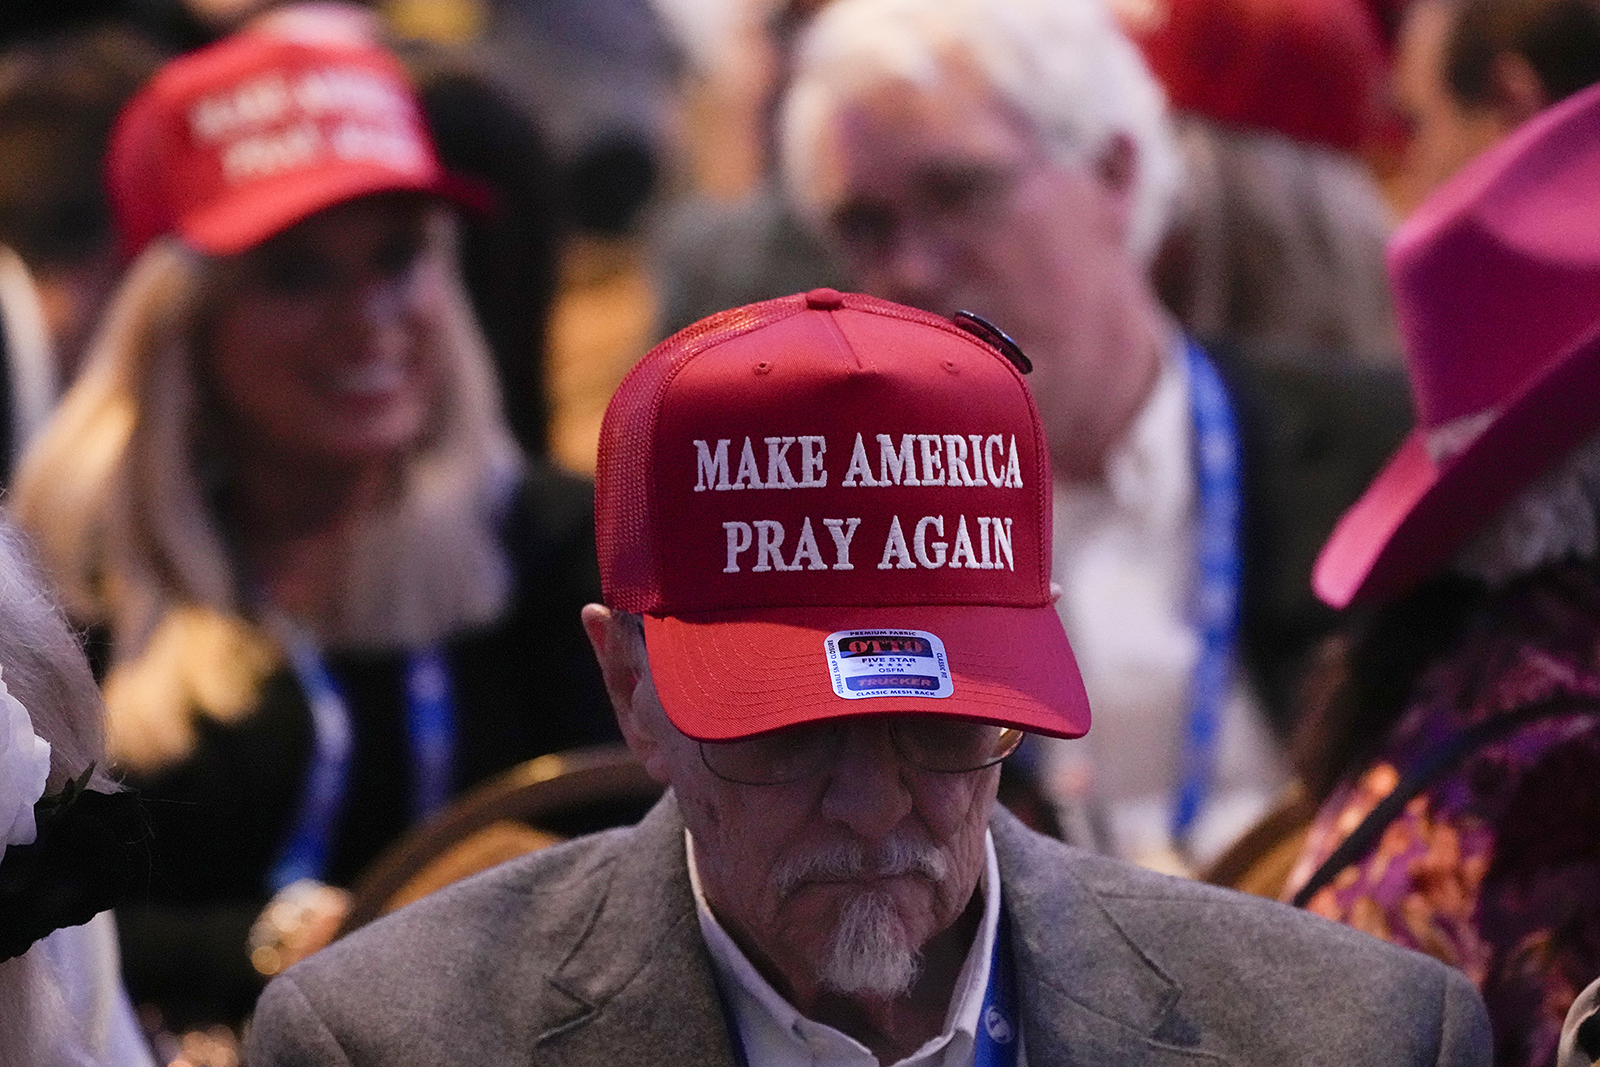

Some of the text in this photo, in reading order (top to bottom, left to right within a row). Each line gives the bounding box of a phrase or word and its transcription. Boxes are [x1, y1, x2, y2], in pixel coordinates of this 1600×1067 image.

[693, 432, 1023, 492] MAKE AMERICA
[722, 514, 1015, 573] PRAY AGAIN
[827, 639, 837, 659] CLOSURE
[848, 640, 923, 654] OTTO
[831, 660, 840, 673] SNAP
[936, 652, 947, 671] CLASSIC
[858, 677, 932, 687] TRUCKER
